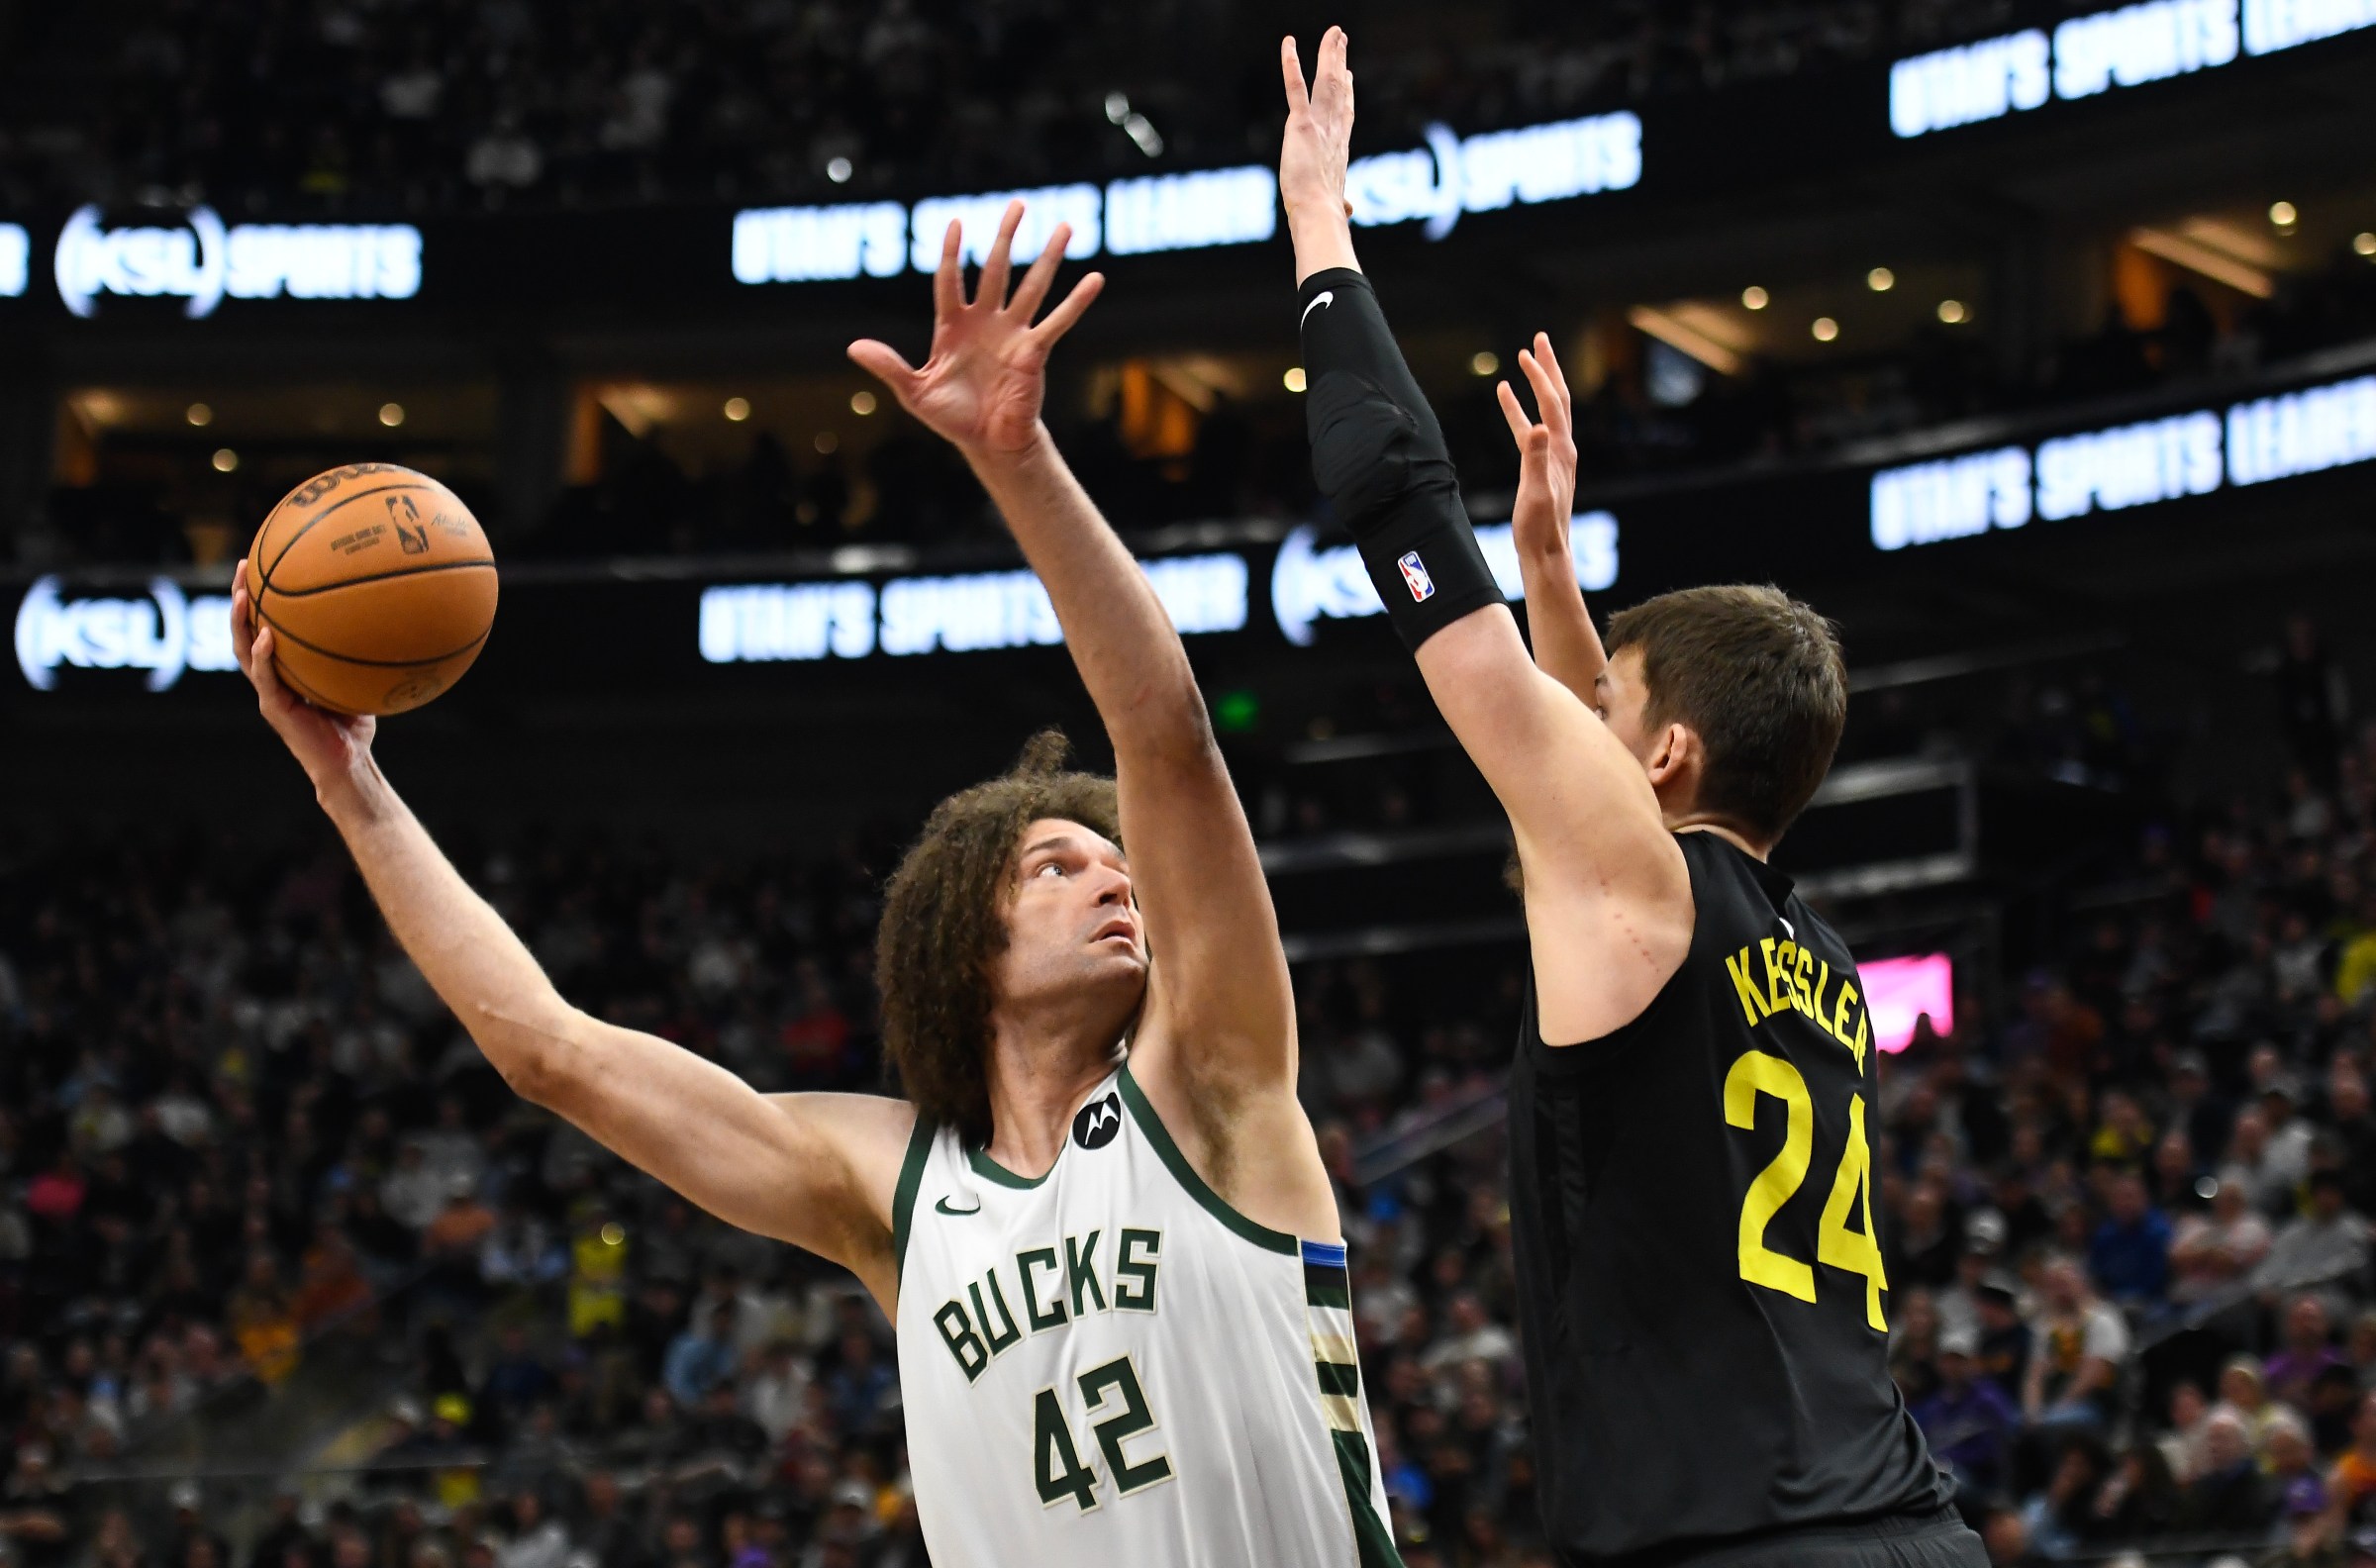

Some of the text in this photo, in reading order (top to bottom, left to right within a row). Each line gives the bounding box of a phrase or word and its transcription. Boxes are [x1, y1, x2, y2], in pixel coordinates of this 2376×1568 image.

[2052, 0, 2239, 100] SPORTS
[1459, 110, 1642, 213] SPORTS
[225, 224, 423, 298] SPORTS
[2035, 409, 2224, 522] SPORTS
[1726, 935, 1870, 1078] KESSLER
[1724, 1049, 1889, 1332] 24
[933, 1226, 1164, 1388] BUCKS
[1032, 1350, 1177, 1517] 42
